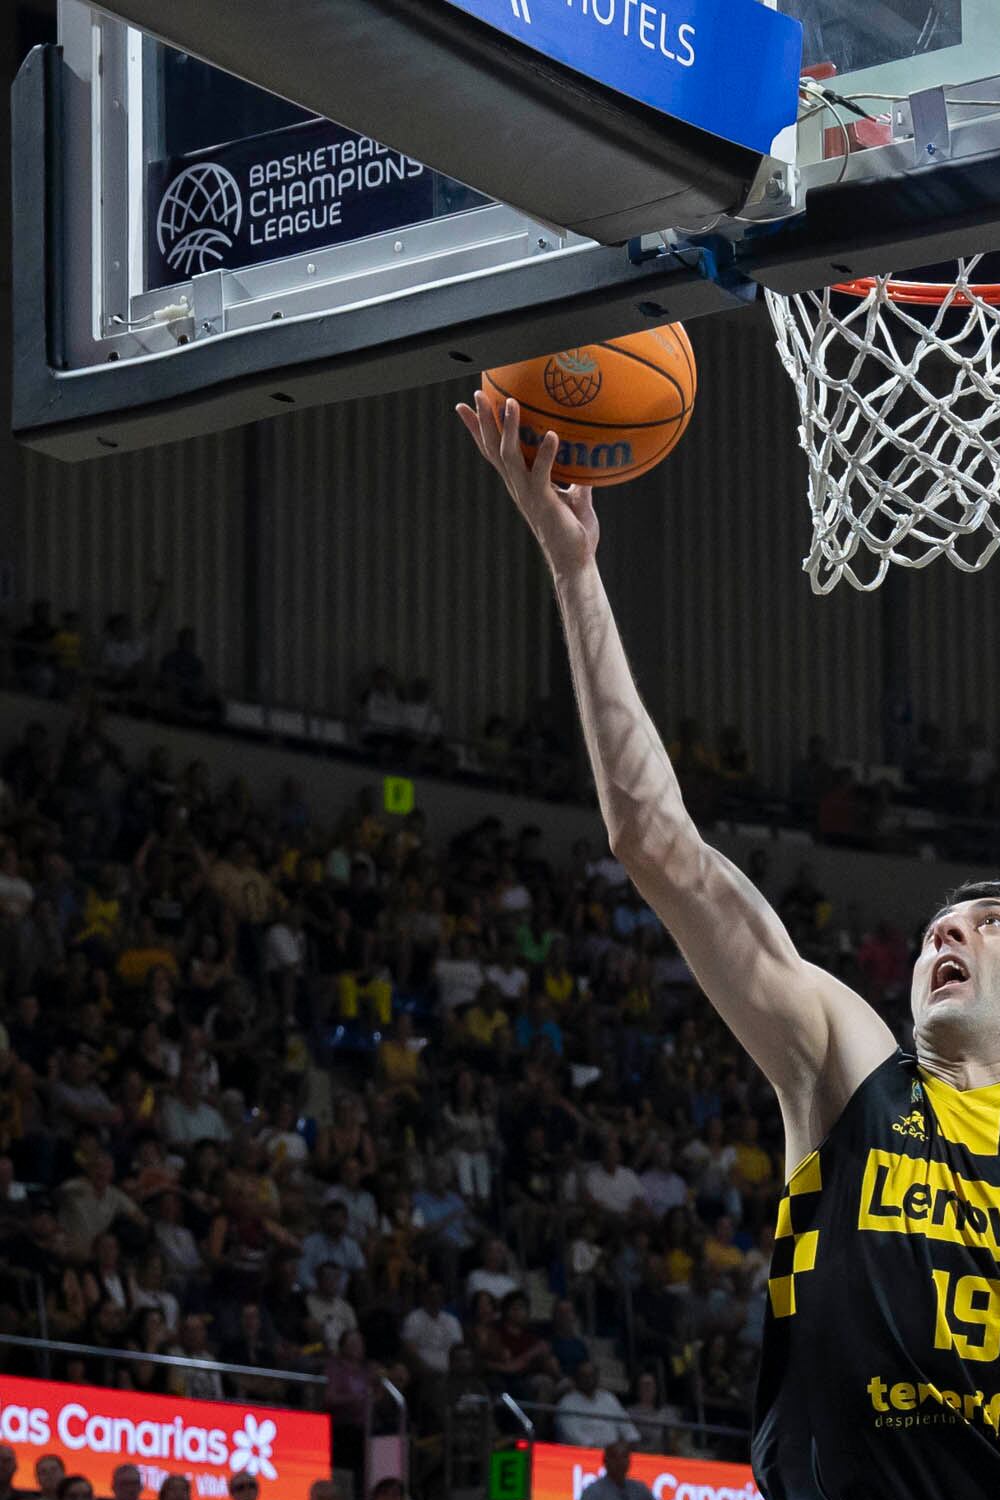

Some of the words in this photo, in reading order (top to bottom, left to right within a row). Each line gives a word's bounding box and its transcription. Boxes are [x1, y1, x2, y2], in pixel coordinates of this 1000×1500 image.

[566, 0, 696, 67] OTELS
[249, 154, 424, 218] CHAMPIONS
[249, 201, 343, 246] LEAGUE
[0, 1404, 50, 1446] as
[57, 1403, 229, 1466] Canarias
